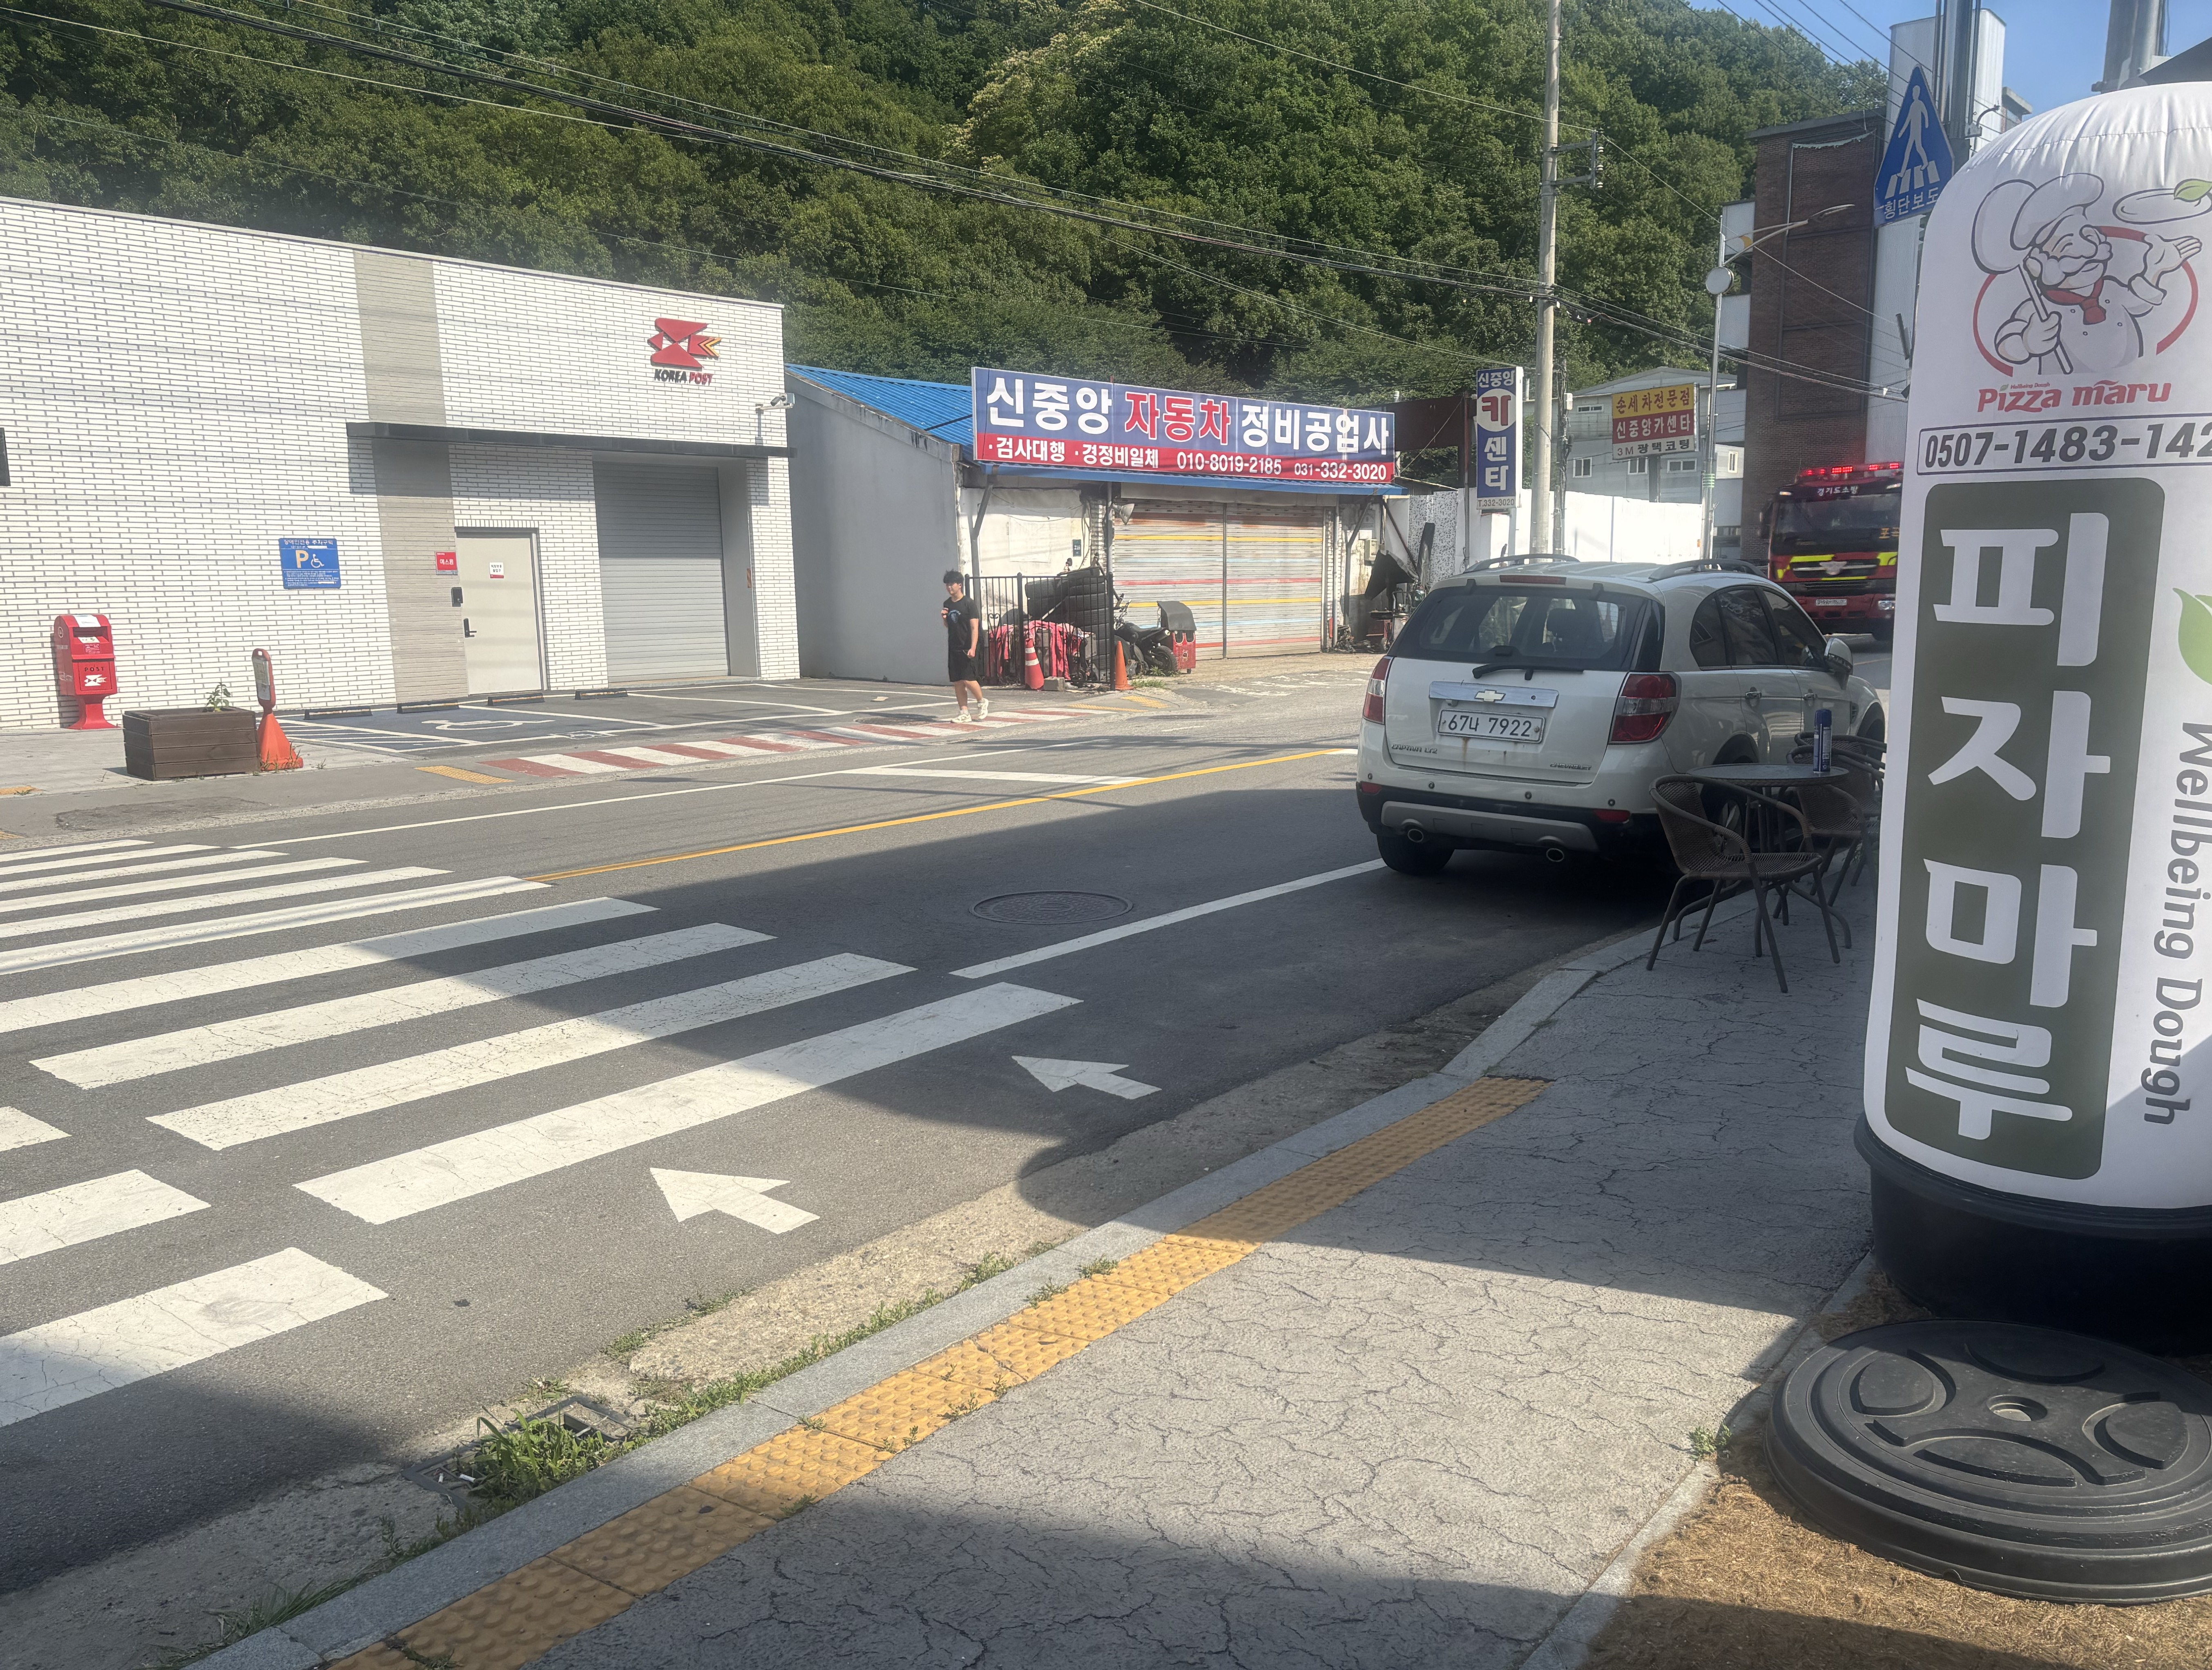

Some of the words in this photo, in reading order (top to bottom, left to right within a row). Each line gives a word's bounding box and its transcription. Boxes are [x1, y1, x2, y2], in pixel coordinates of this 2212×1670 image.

[1884, 187, 1938, 219] 횡단보도
[654, 369, 687, 383] KOREA
[689, 372, 714, 386] POST
[1478, 370, 1515, 388] 신중앙
[1616, 387, 1690, 414] 손세차전문점
[1977, 388, 2062, 412] Pizza
[987, 377, 1112, 435] 신중앙
[1125, 391, 1231, 446] 자동차
[1241, 405, 1389, 455] 정비공업사
[1616, 413, 1690, 439] 신중앙카센타
[996, 437, 1065, 462] 검사대행
[1083, 444, 1158, 469] 경정비일체
[1177, 451, 1282, 475] 010-8019-2185
[1294, 462, 1387, 481] 031-332-3020
[1638, 439, 1690, 454] 광택코팅
[1478, 498, 1514, 508] T.332-3020
[295, 550, 309, 568] P
[1448, 715, 1479, 731] 67나
[1489, 717, 1531, 737] 7922
[1391, 744, 1422, 752] CAPTIVA
[1905, 512, 2111, 1140] 피자마루
[2154, 722, 2212, 959] Wellbeing
[2141, 977, 2203, 1125] Dough
